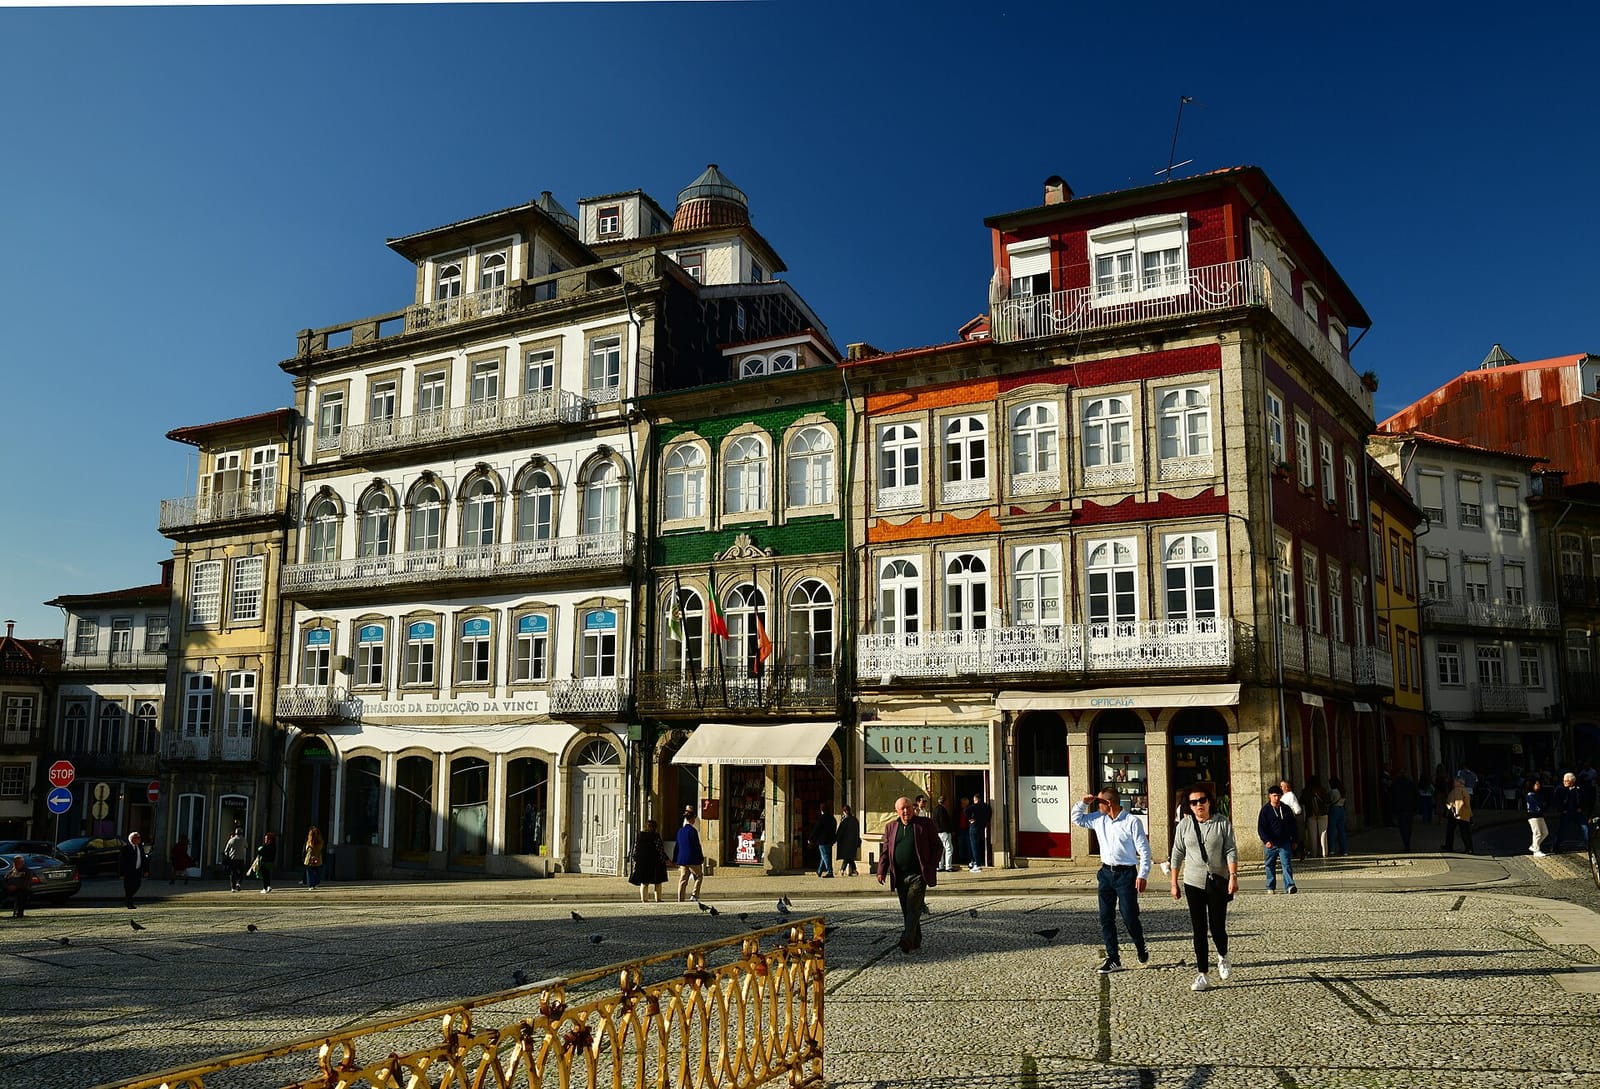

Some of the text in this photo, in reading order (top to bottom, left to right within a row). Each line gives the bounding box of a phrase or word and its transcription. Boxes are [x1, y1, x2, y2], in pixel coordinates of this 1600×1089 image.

[408, 703, 423, 713] DA
[426, 700, 479, 715] EDUCAÇÃO
[483, 702, 499, 712] DA
[503, 701, 539, 712] VINCI
[50, 769, 74, 780] STOP
